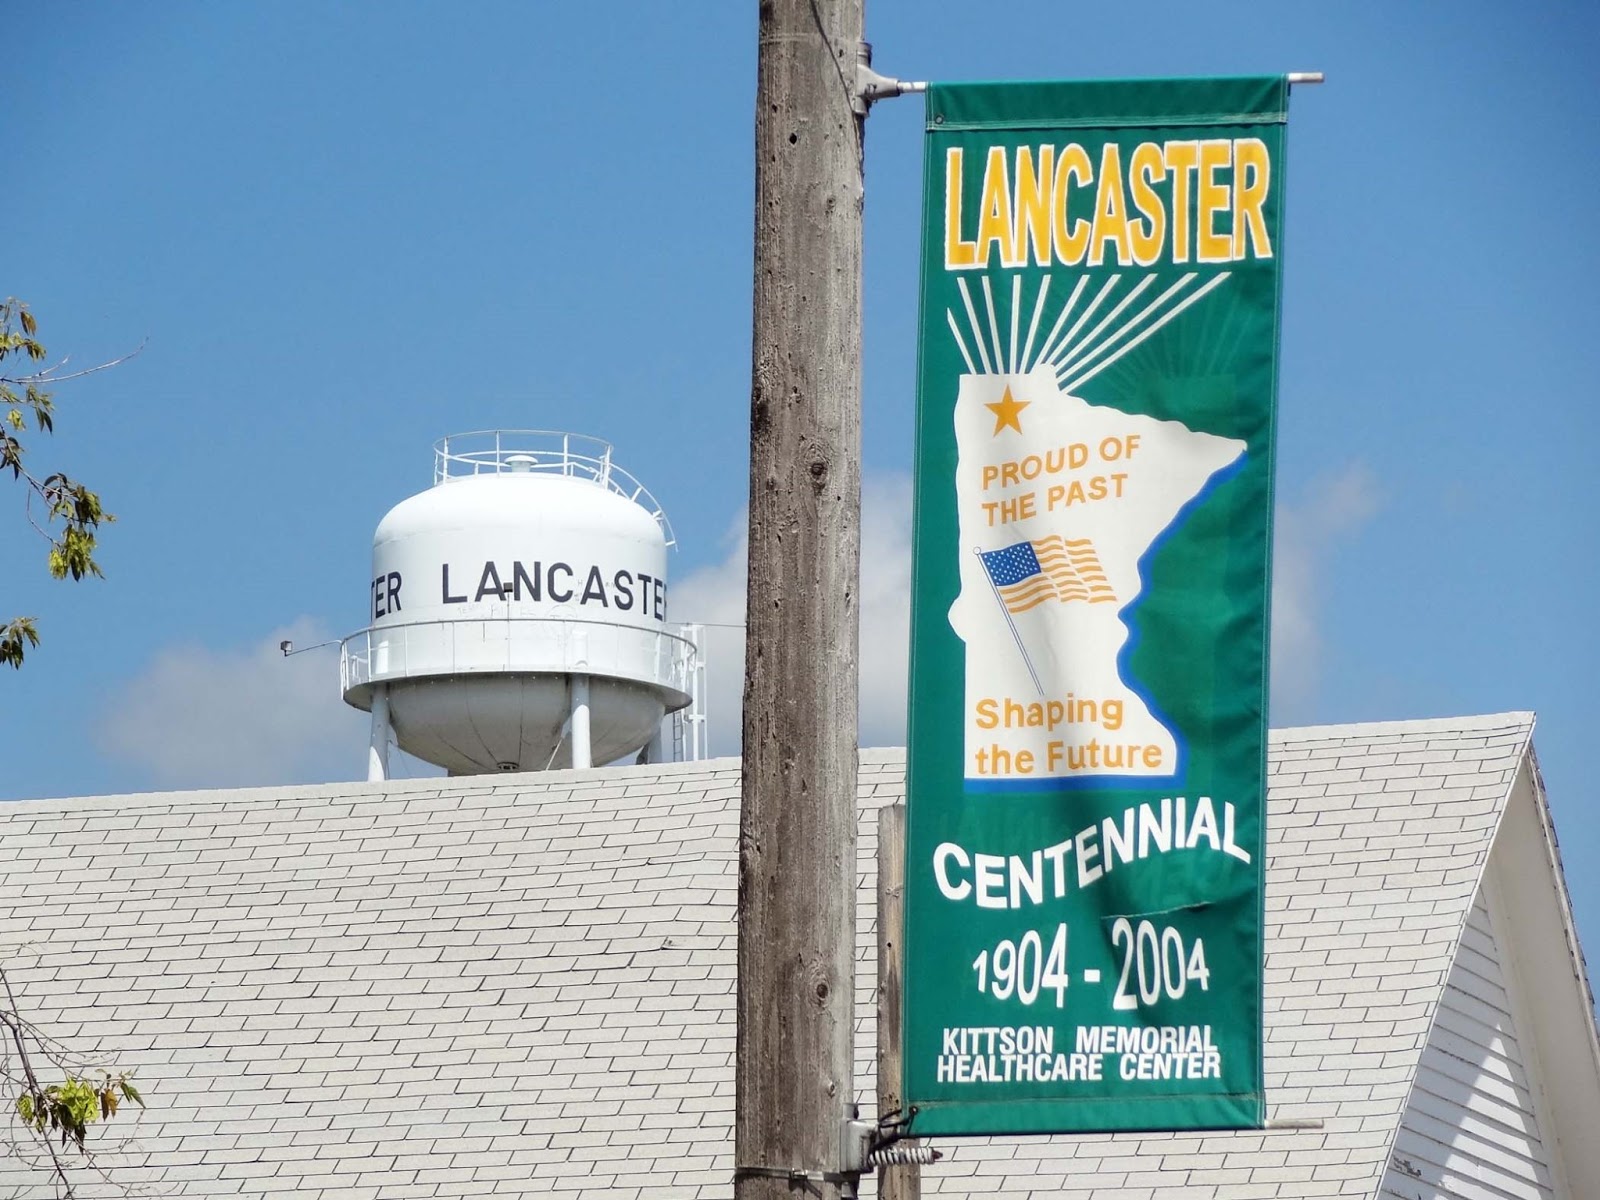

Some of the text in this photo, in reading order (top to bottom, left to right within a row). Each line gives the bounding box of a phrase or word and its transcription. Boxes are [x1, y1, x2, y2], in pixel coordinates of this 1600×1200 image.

[945, 138, 1273, 270] LANCASTER
[982, 435, 1141, 490] PROUD OF
[981, 473, 1128, 527] THE PAST
[442, 561, 667, 622] LANCASTE
[975, 693, 1124, 731] Shaping
[975, 737, 1162, 775] the Future
[932, 796, 1251, 909] CENTENNIAL
[972, 922, 1068, 1009] 1904
[1112, 917, 1210, 1011] 2004
[937, 1052, 1221, 1082] HEALTHCARE CENTER
[943, 1025, 1218, 1055] KITTSON MEMORIAL
